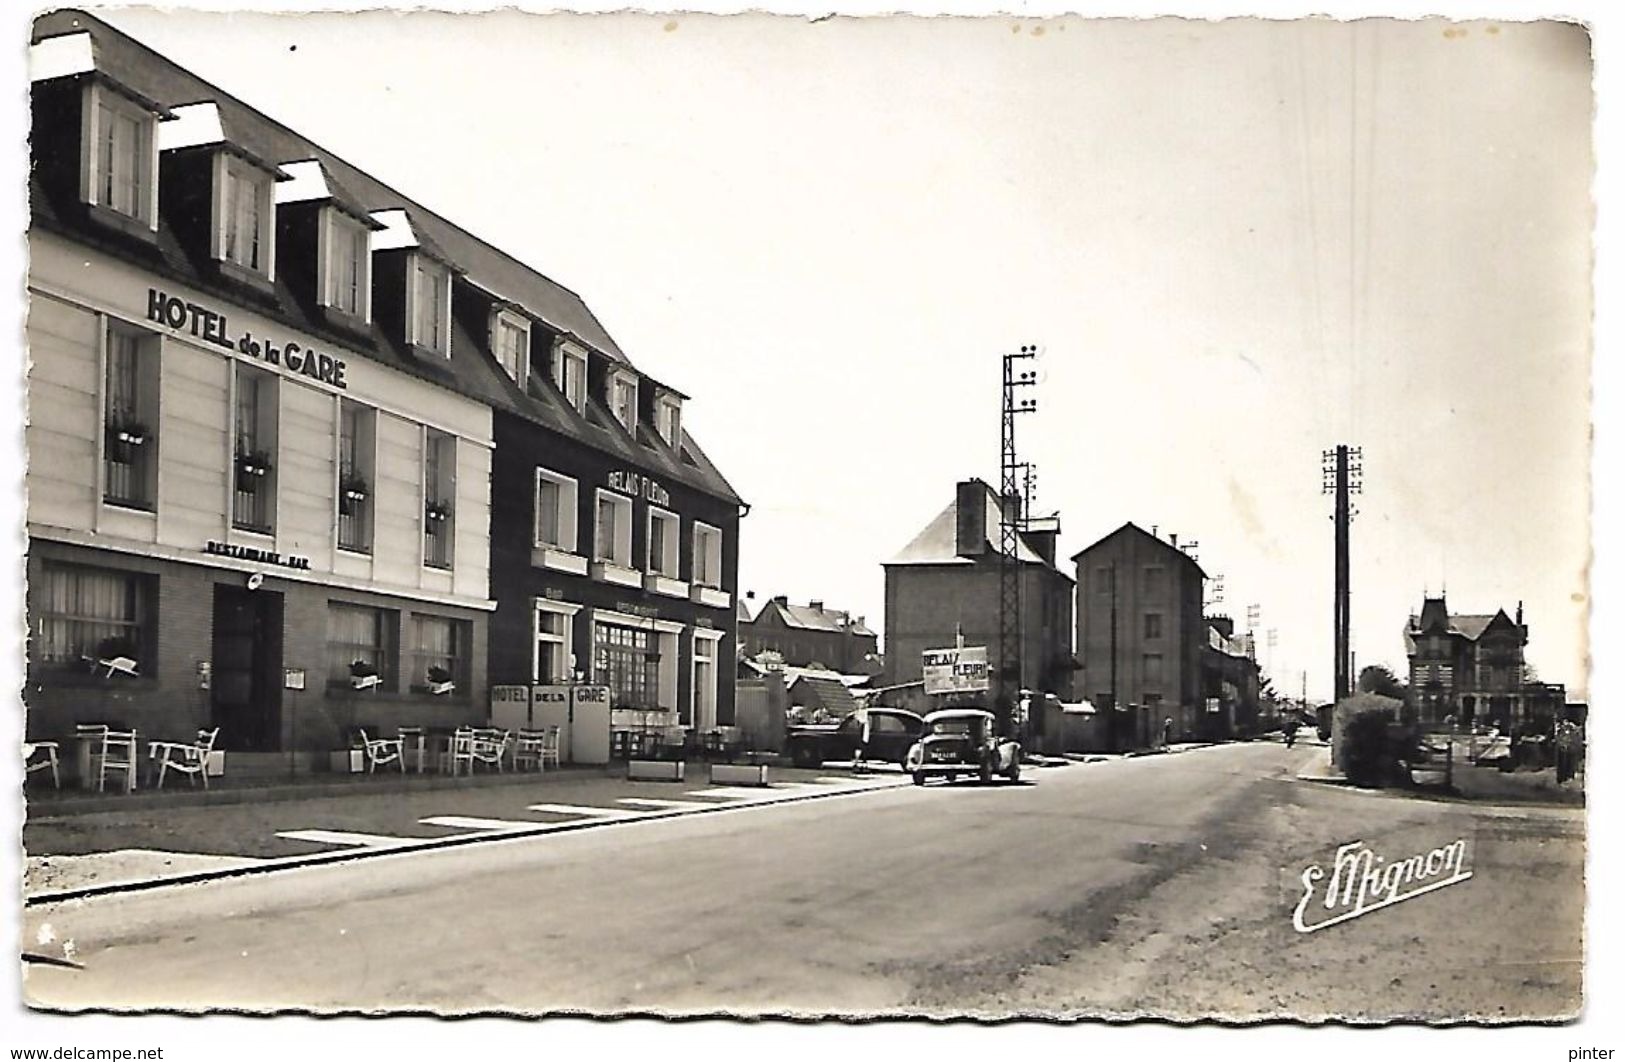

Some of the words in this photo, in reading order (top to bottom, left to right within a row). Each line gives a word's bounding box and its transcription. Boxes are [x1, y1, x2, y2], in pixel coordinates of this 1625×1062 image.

[148, 288, 234, 349] HOTEL
[239, 332, 261, 358] de
[265, 340, 280, 365] la
[285, 342, 347, 390] GARE
[608, 471, 638, 496] RELAIS
[492, 686, 527, 703] HOTEL
[577, 687, 606, 703] GARE
